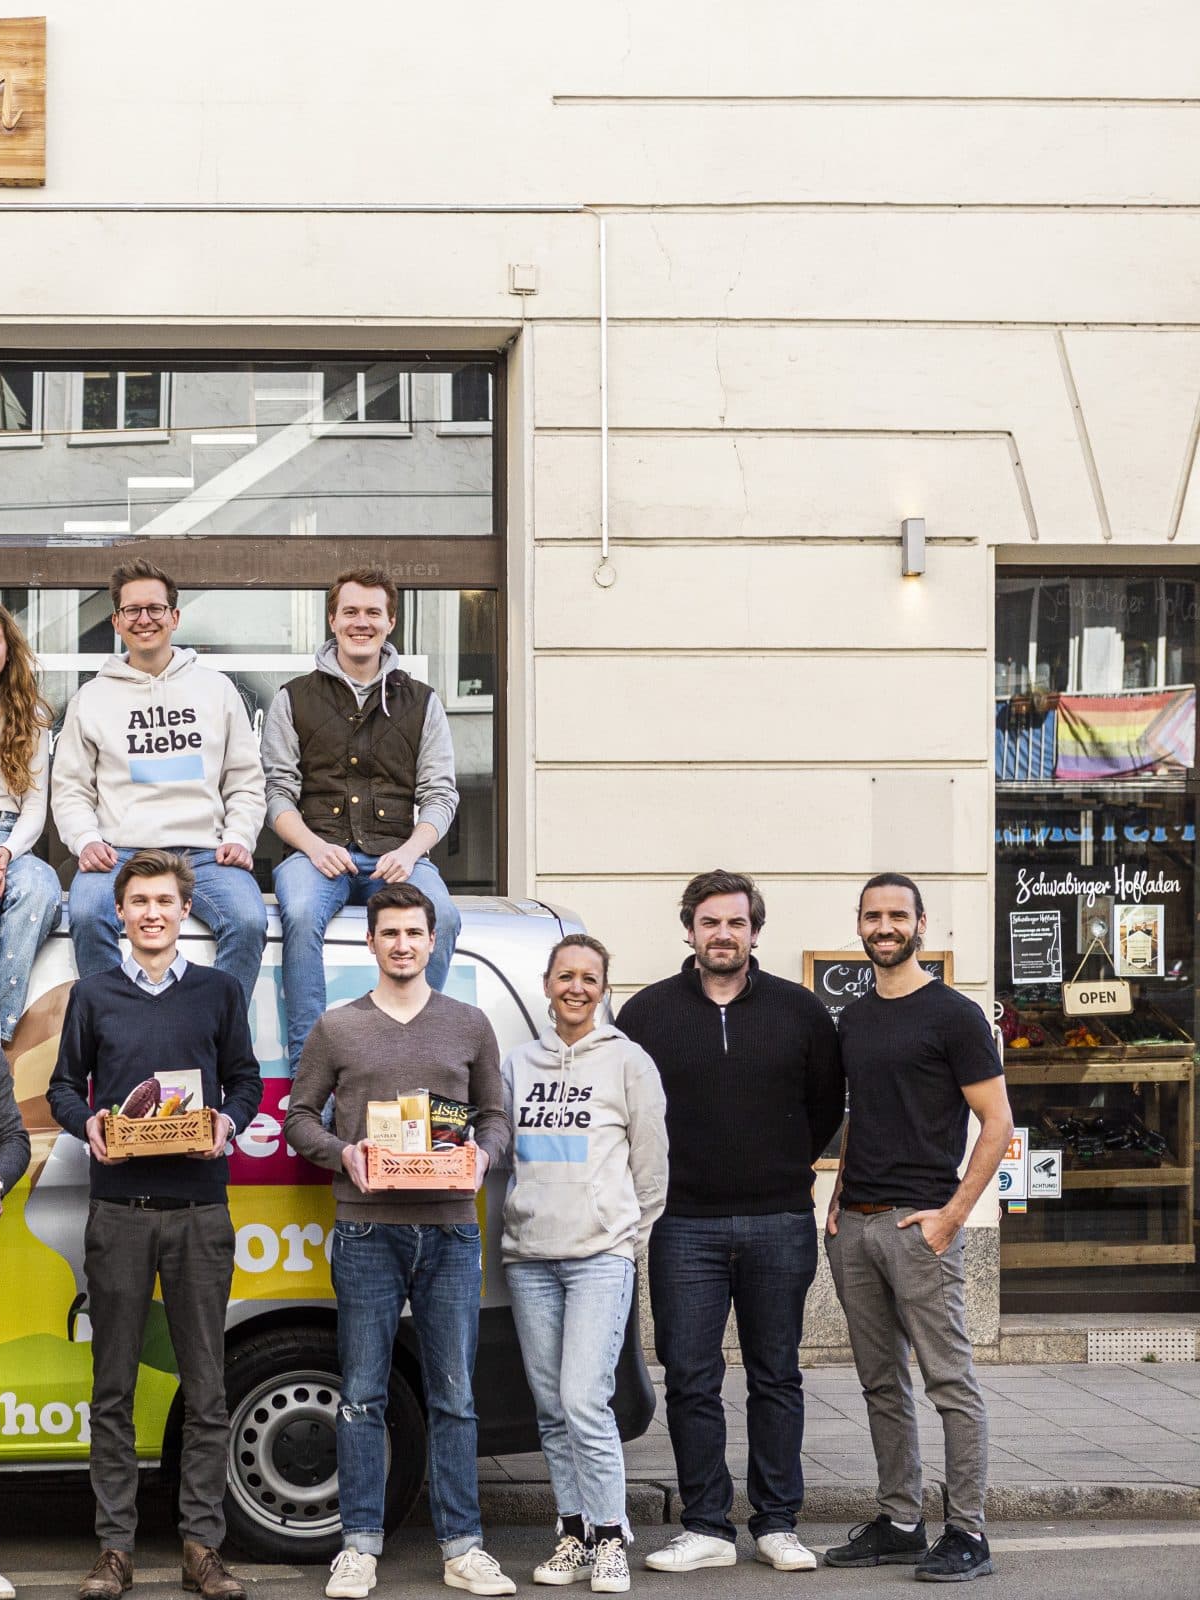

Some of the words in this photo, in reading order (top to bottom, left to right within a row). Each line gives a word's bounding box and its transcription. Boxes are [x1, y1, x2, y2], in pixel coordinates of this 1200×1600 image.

[127, 705, 197, 730] Alles
[126, 729, 202, 754] Liebe
[1015, 868, 1112, 908] Schwabinger
[1114, 863, 1182, 904] Hofladen
[823, 963, 876, 996] Coff
[1079, 990, 1117, 1004] OPEN
